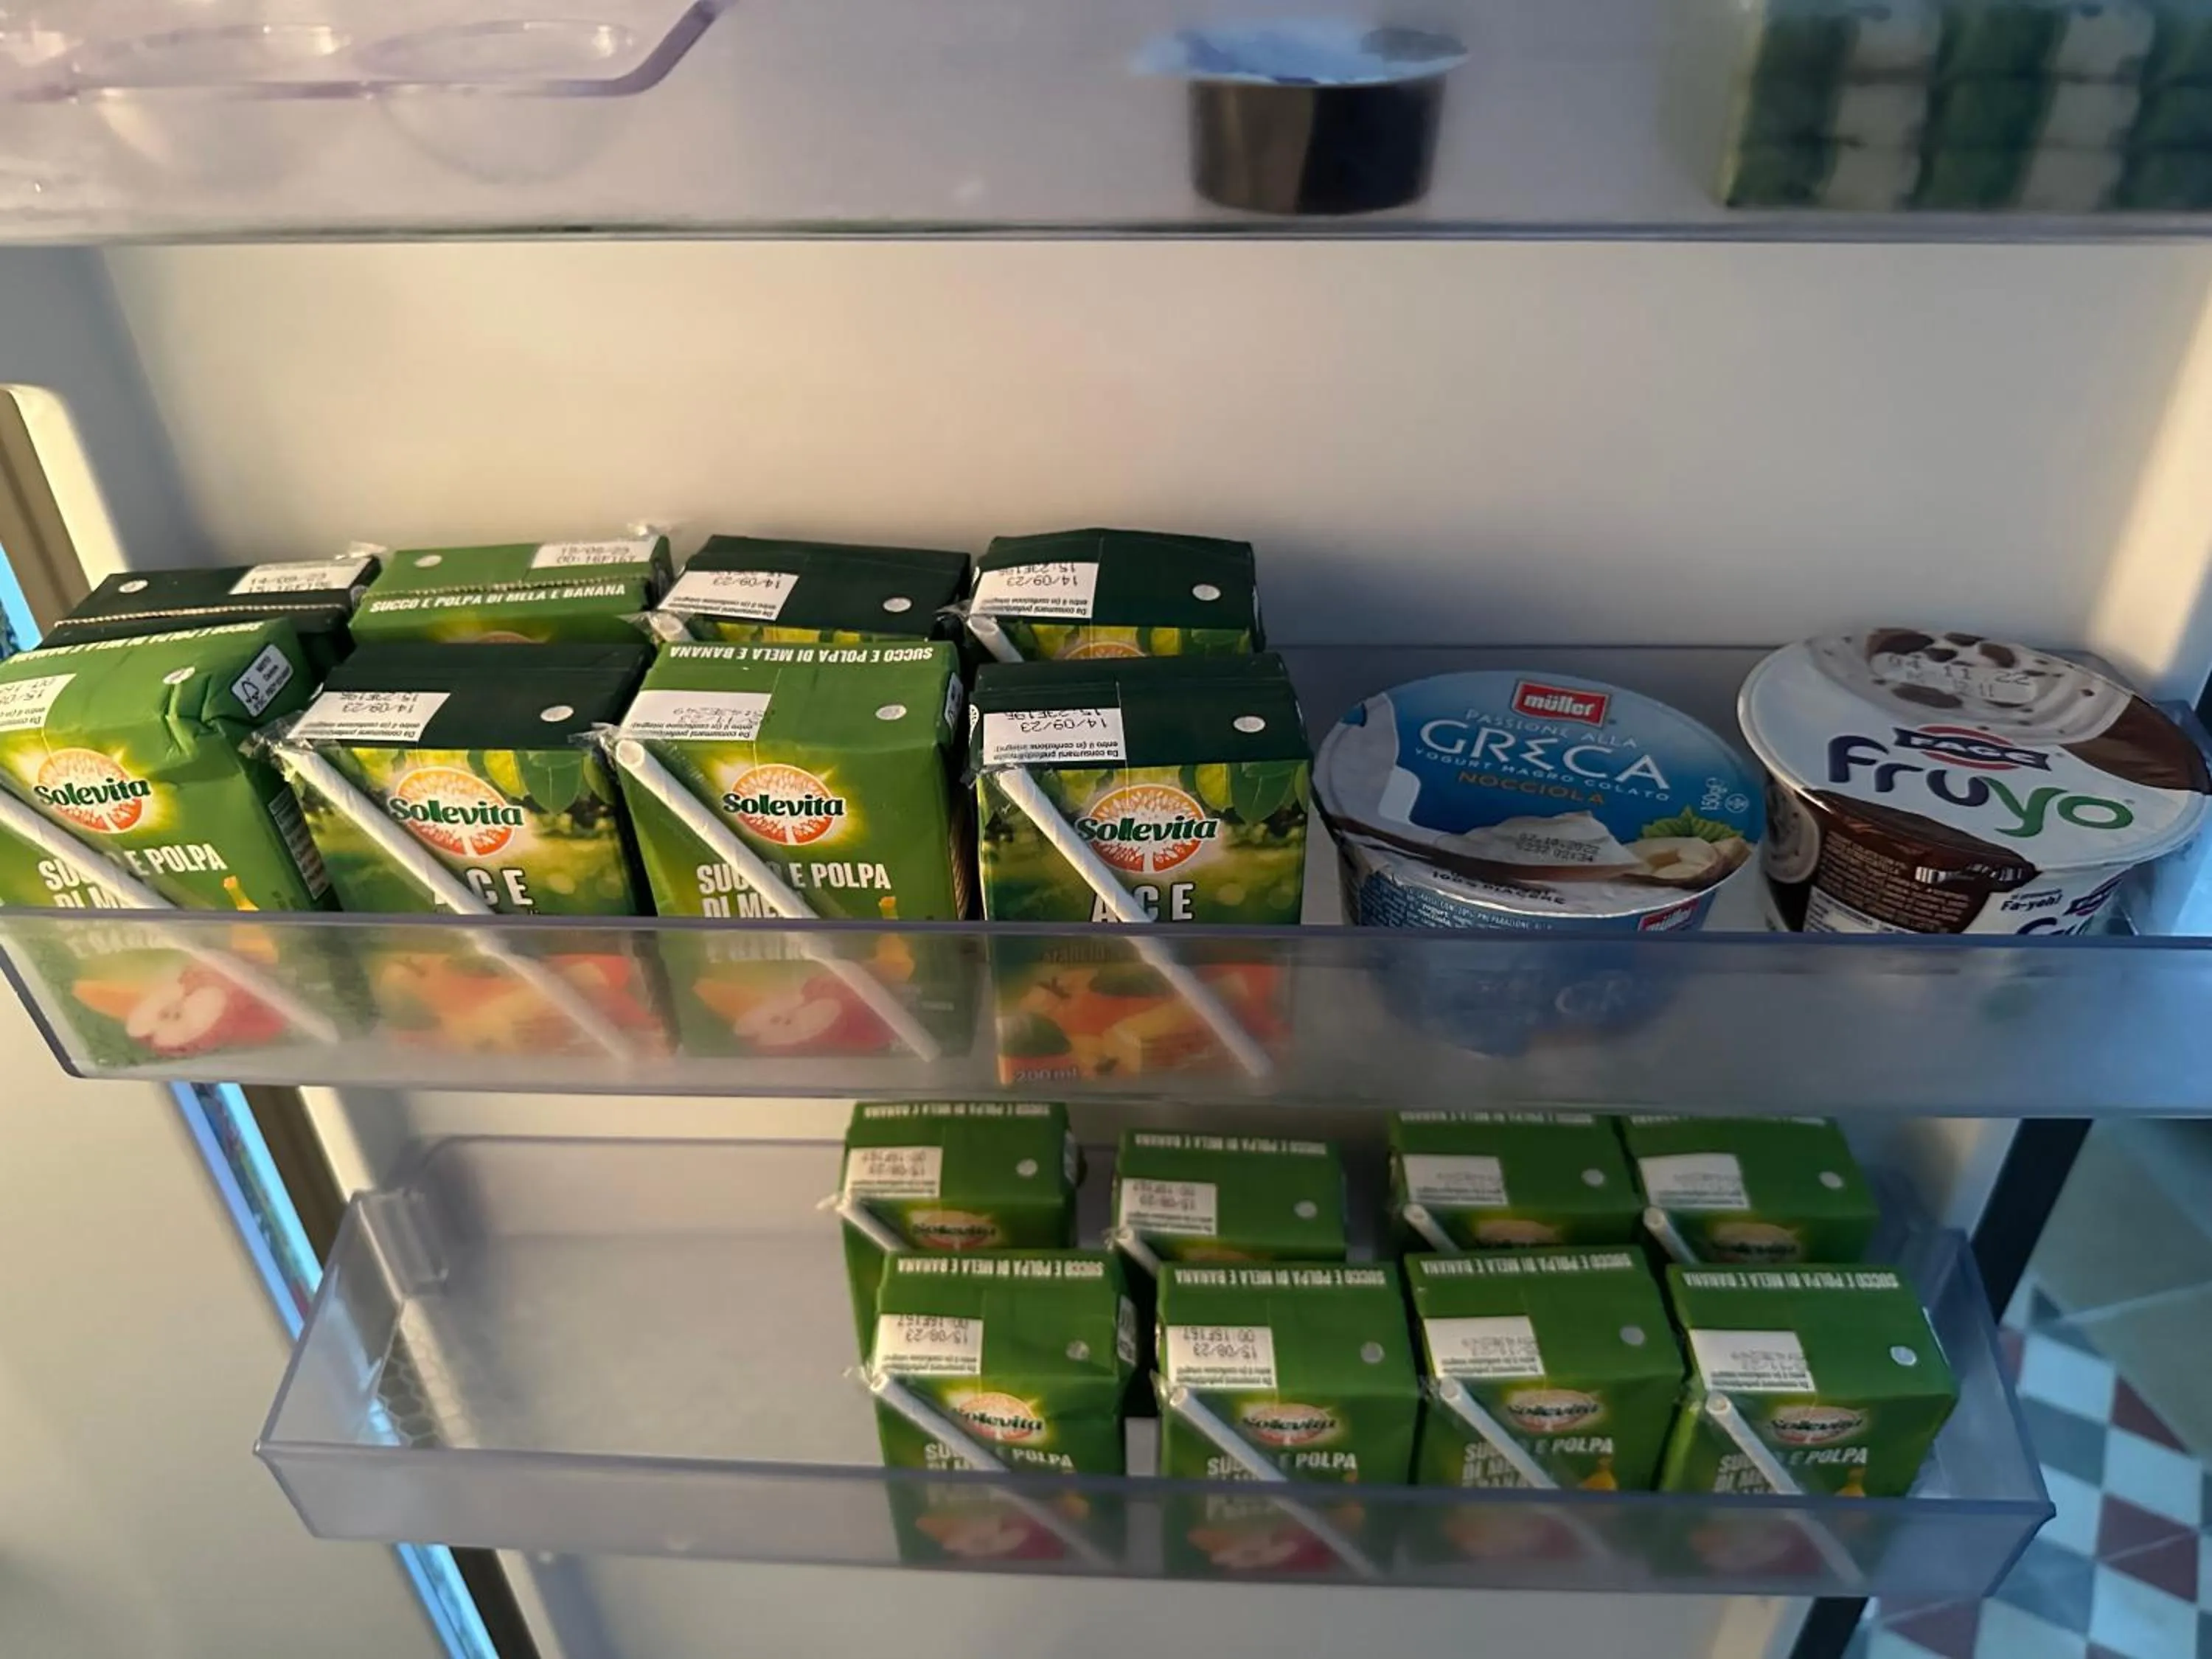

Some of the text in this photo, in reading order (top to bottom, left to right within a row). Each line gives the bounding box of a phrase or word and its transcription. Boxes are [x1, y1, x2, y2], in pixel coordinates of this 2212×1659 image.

[1006, 574, 1078, 587] 14/09/23
[369, 600, 417, 613] SUCCO
[434, 595, 481, 608] POLPA
[507, 591, 546, 602] MELA
[564, 584, 625, 597] BANANA
[669, 646, 933, 662] SUCCO E POLPA DI MELA E BANANA
[1524, 695, 1594, 717] müller
[1020, 718, 1107, 732] 14/09/23
[1467, 709, 1638, 748] PASSIONE ALLA
[1420, 720, 1670, 790] GRECA
[1416, 748, 1670, 801] YOGURT MAGRO COLATO
[1458, 771, 1604, 804] NOCCIOLA
[34, 777, 151, 807] Solevita
[723, 793, 844, 816] Solevita
[389, 797, 524, 827] Solevita
[1077, 815, 1217, 841] Solevita
[125, 849, 150, 876] E
[144, 844, 227, 874] POLPA
[789, 862, 805, 888] E
[811, 862, 891, 890] POLPA
[1012, 1447, 1074, 1467] POLPA
[1295, 1450, 1357, 1470] POLPA
[1805, 1446, 1868, 1465] POLPA
